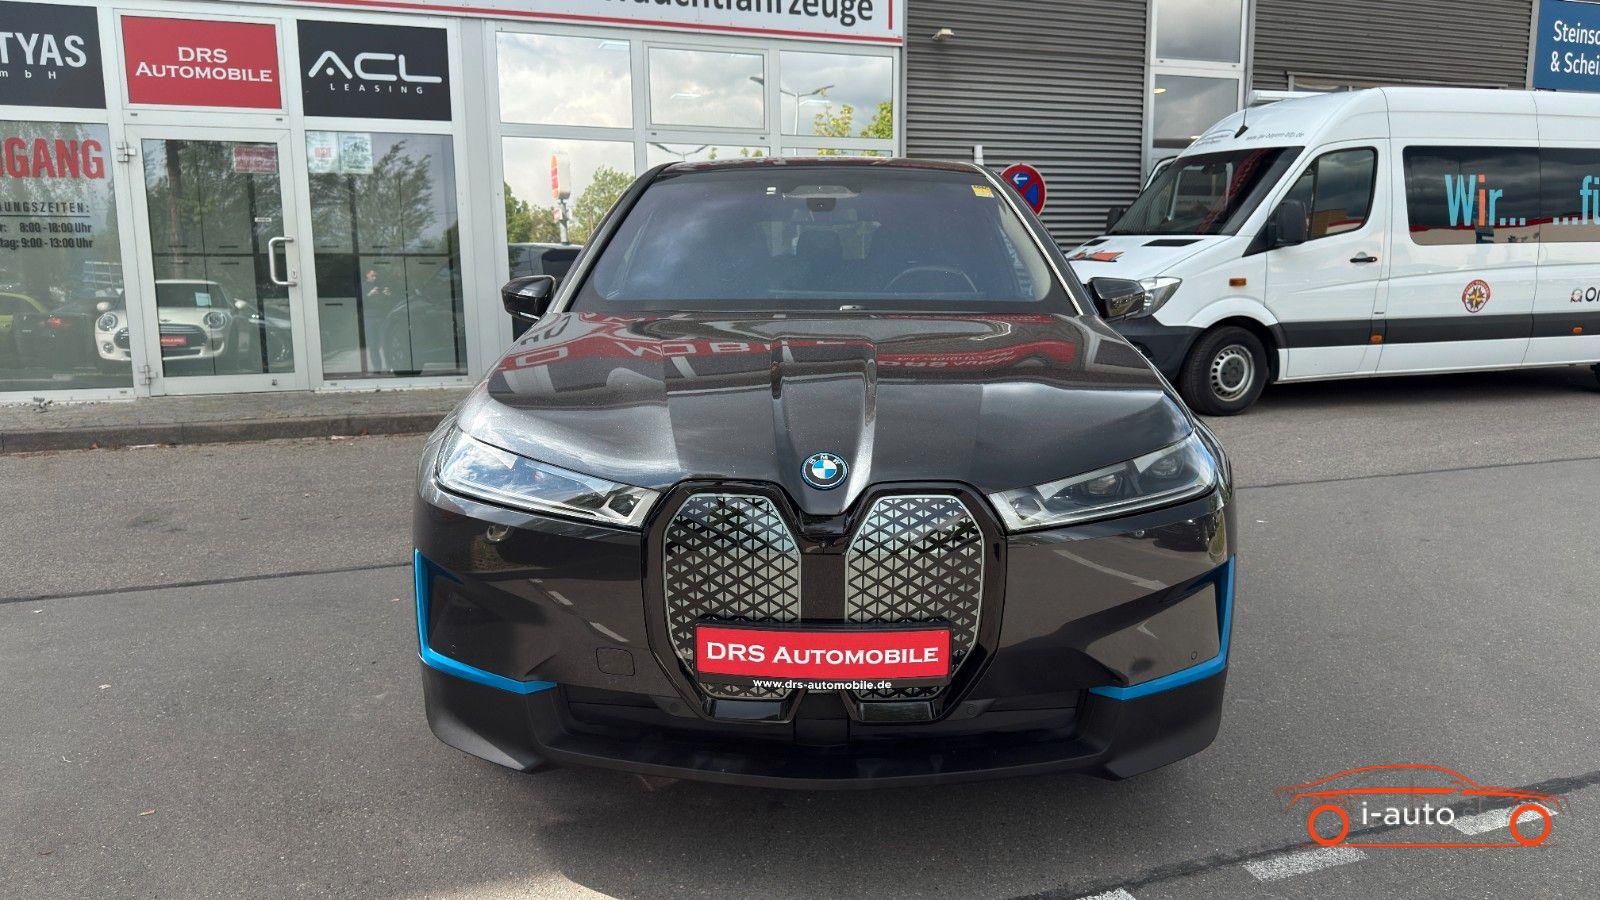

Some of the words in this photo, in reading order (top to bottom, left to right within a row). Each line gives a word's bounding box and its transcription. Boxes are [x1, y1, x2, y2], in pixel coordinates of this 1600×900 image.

[0, 31, 87, 68] TYAS
[178, 47, 228, 64] DRS
[308, 50, 442, 84] ACL
[1551, 51, 1560, 72] &
[330, 83, 424, 95] LEASING
[0, 136, 105, 180] GANG
[0, 201, 90, 213] UNGSZEITEN:
[1444, 174, 1526, 226] Wir...
[19, 222, 41, 233] 8:00
[48, 222, 73, 233] 18:00
[75, 222, 92, 233] Uhr
[21, 237, 42, 248] 9:00
[50, 238, 75, 248] 13:00
[76, 238, 94, 249] Uhr
[707, 641, 765, 663] DRS
[752, 679, 892, 690] www.drs-automobile.de
